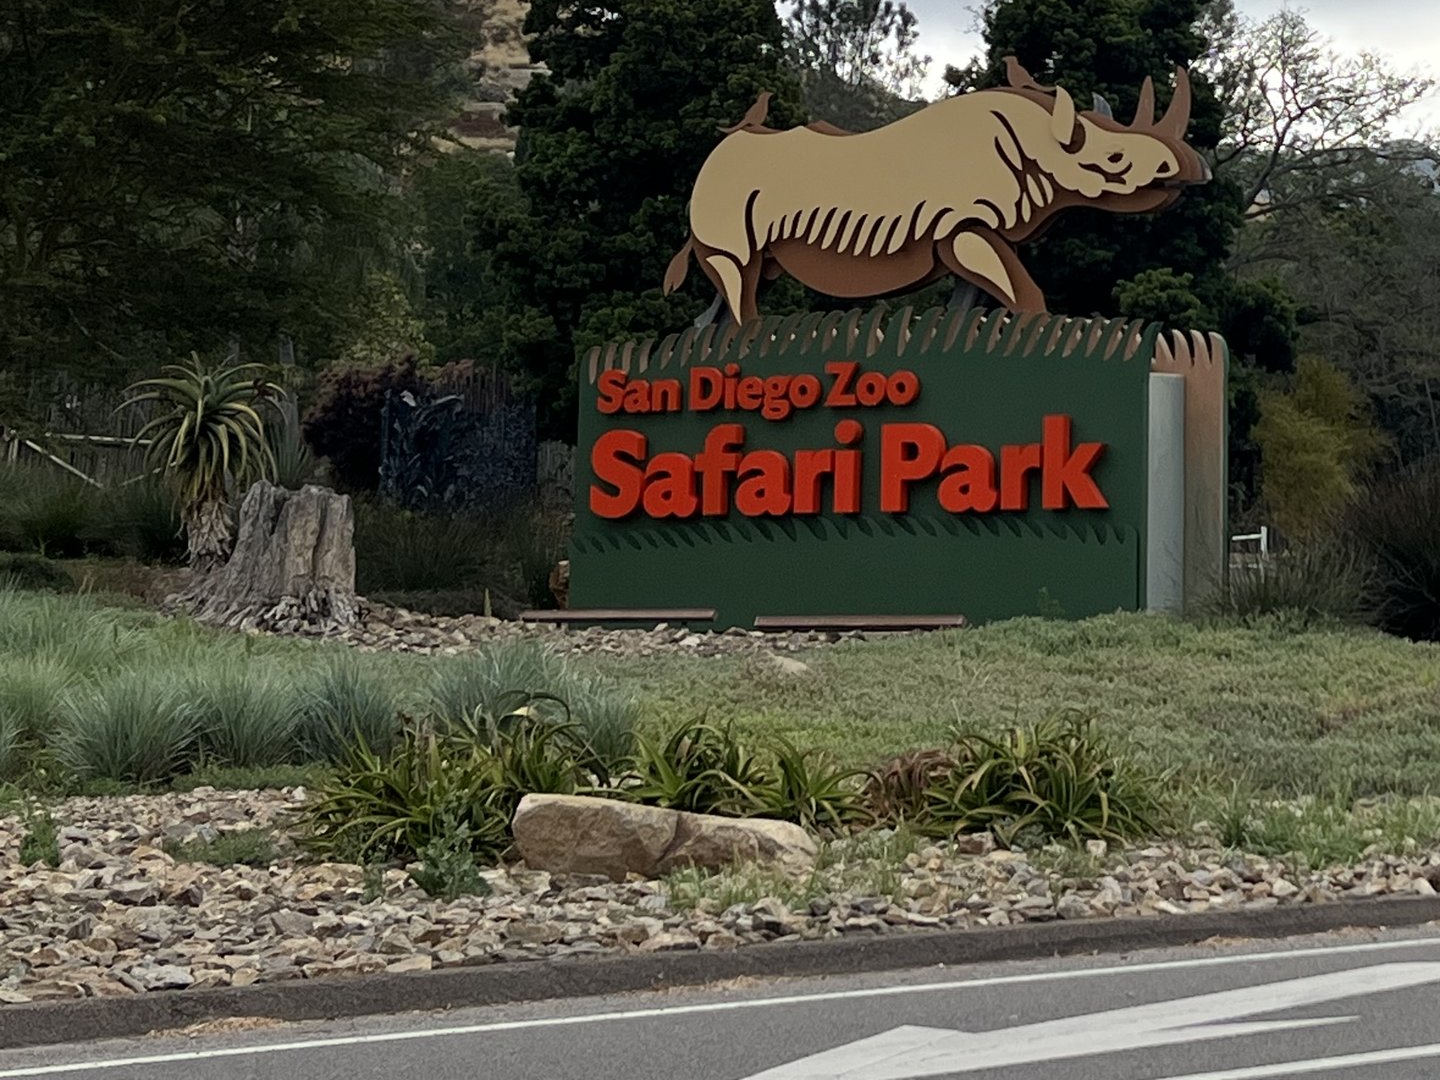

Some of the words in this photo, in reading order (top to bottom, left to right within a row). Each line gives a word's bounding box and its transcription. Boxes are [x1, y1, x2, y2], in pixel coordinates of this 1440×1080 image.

[597, 369, 681, 414] San
[689, 363, 821, 419] Diego
[824, 361, 920, 407] Zoo
[590, 420, 863, 518] Safari
[880, 414, 1109, 513] Park
